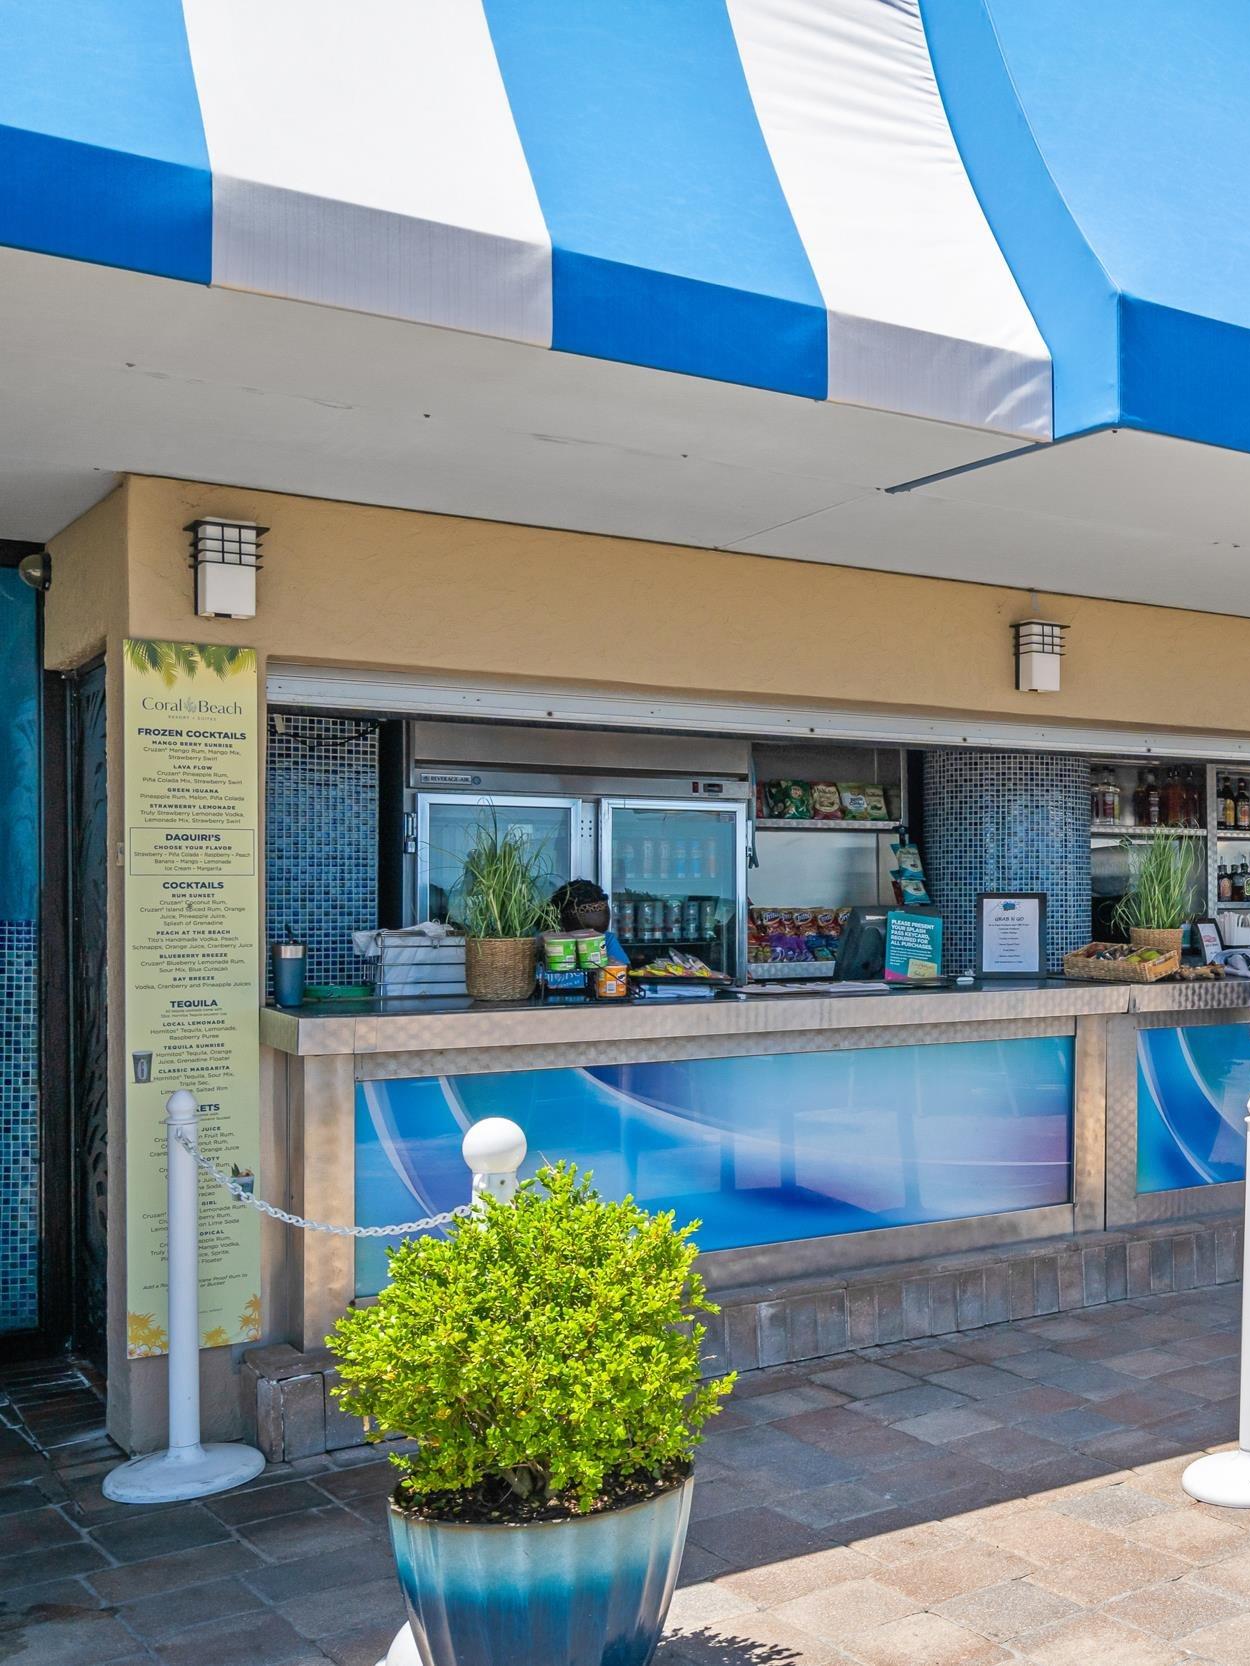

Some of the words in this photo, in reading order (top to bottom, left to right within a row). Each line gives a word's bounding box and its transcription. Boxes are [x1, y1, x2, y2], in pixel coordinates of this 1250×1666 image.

[142, 697, 182, 711] Coral
[199, 700, 242, 715] Beach
[138, 728, 183, 737] FROZEN
[186, 730, 246, 740] COCKTAILS
[170, 1000, 218, 1008] TEQUILA
